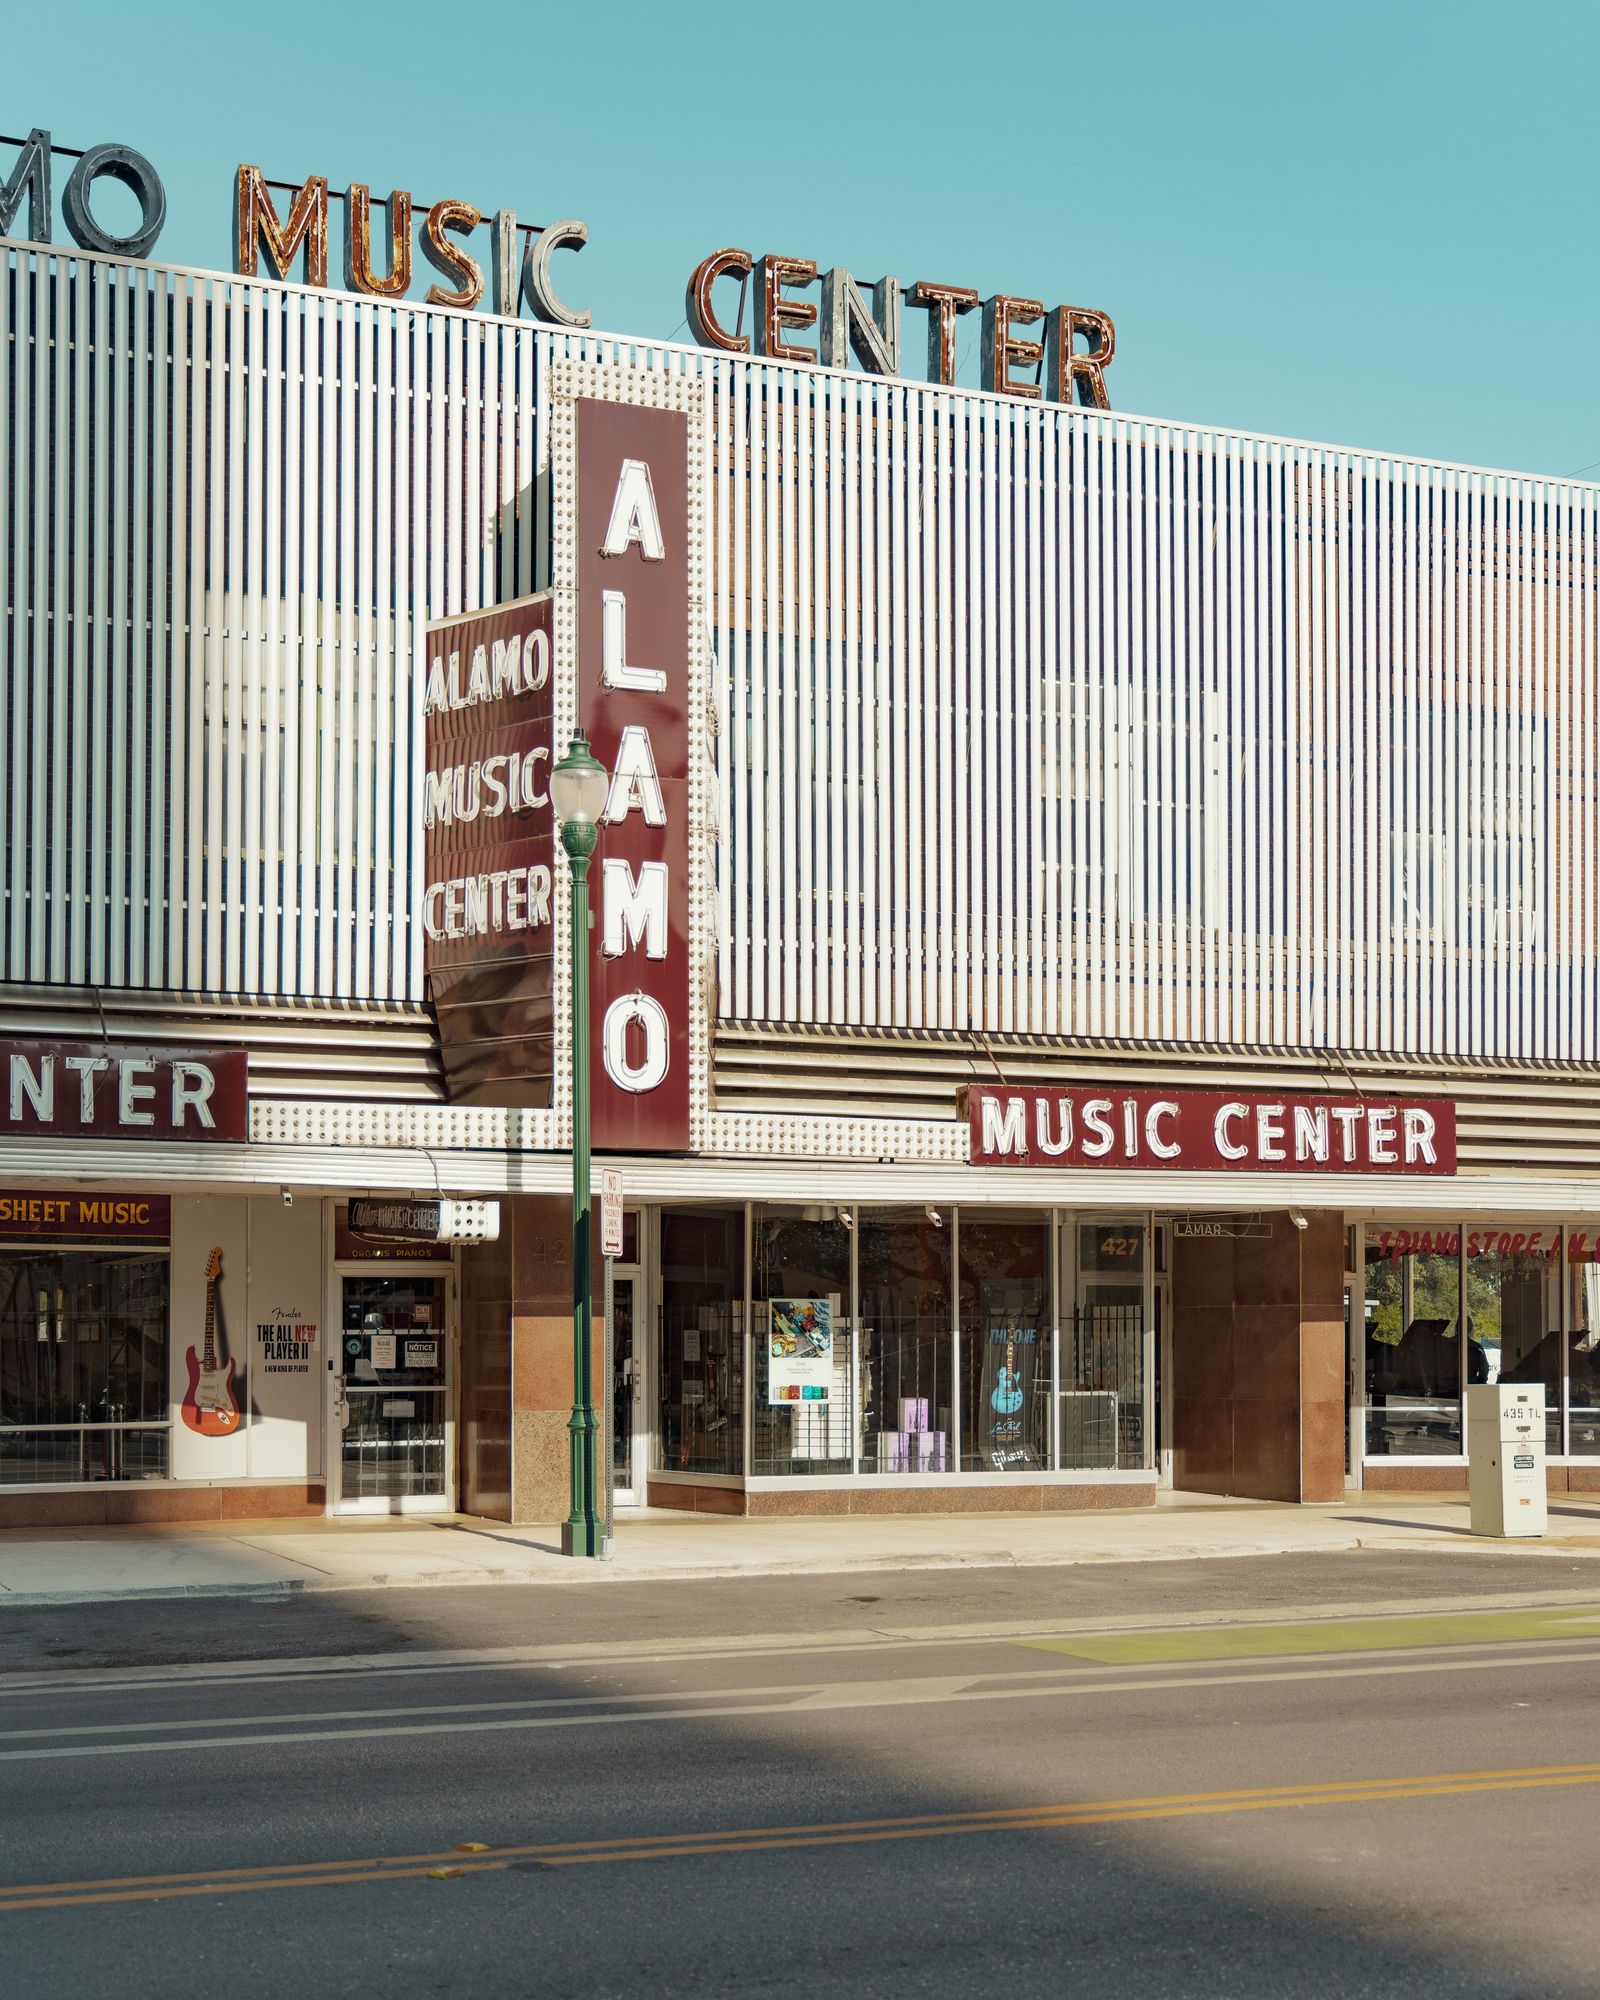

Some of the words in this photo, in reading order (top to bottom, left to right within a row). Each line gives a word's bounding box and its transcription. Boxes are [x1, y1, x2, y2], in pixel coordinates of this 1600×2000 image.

[233, 163, 592, 328] MUSIC
[686, 247, 1116, 411] CENTER
[424, 629, 549, 716] ALAMO
[600, 457, 671, 1095] ALAMO
[424, 747, 549, 829] MUSIC
[424, 865, 551, 941] CENTER
[9, 1054, 217, 1128] NTER
[981, 1095, 1181, 1159] MUSIC
[1214, 1103, 1436, 1164] CENTER
[608, 1176, 616, 1191] NO
[0, 1199, 71, 1223] SHEET
[79, 1201, 150, 1225] MUSIC
[352, 1249, 390, 1257] ORGANS
[396, 1249, 432, 1257] PIANOS
[1100, 1238, 1138, 1256] 427
[1391, 1230, 1459, 1265] PIANO
[1467, 1231, 1543, 1258] STORE
[271, 1306, 302, 1320] Fender
[256, 1324, 275, 1342] THE
[276, 1324, 293, 1342] ALL
[294, 1324, 317, 1342] NEW
[1014, 1328, 1037, 1345] ONE
[264, 1342, 300, 1360] PLAYER
[301, 1342, 309, 1360] II
[408, 1344, 433, 1352] NOTICE
[1503, 1408, 1523, 1419] 435
